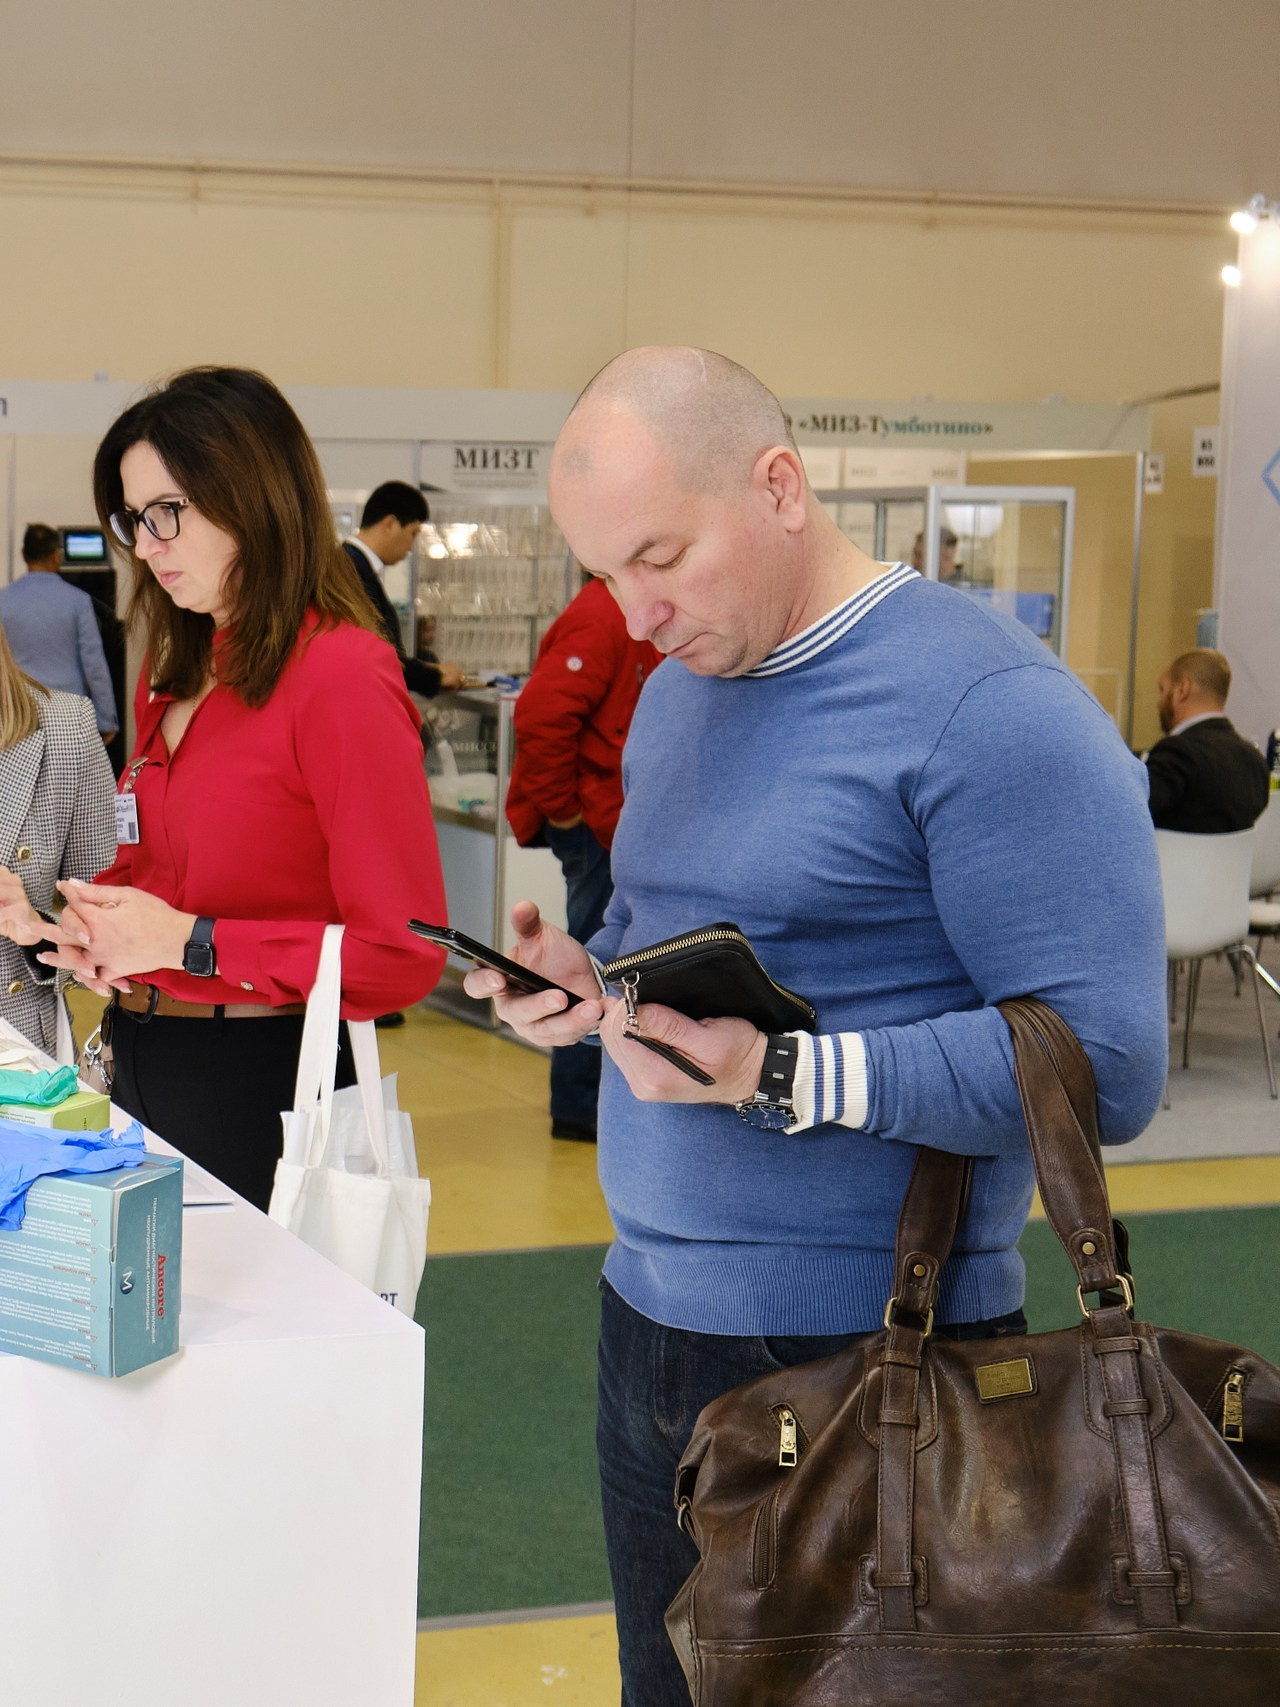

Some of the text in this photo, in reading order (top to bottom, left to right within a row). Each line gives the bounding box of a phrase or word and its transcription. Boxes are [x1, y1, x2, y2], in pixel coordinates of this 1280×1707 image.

[454, 448, 539, 469] МИЗТ
[122, 1271, 133, 1291] M
[157, 1254, 167, 1317] Ancore
